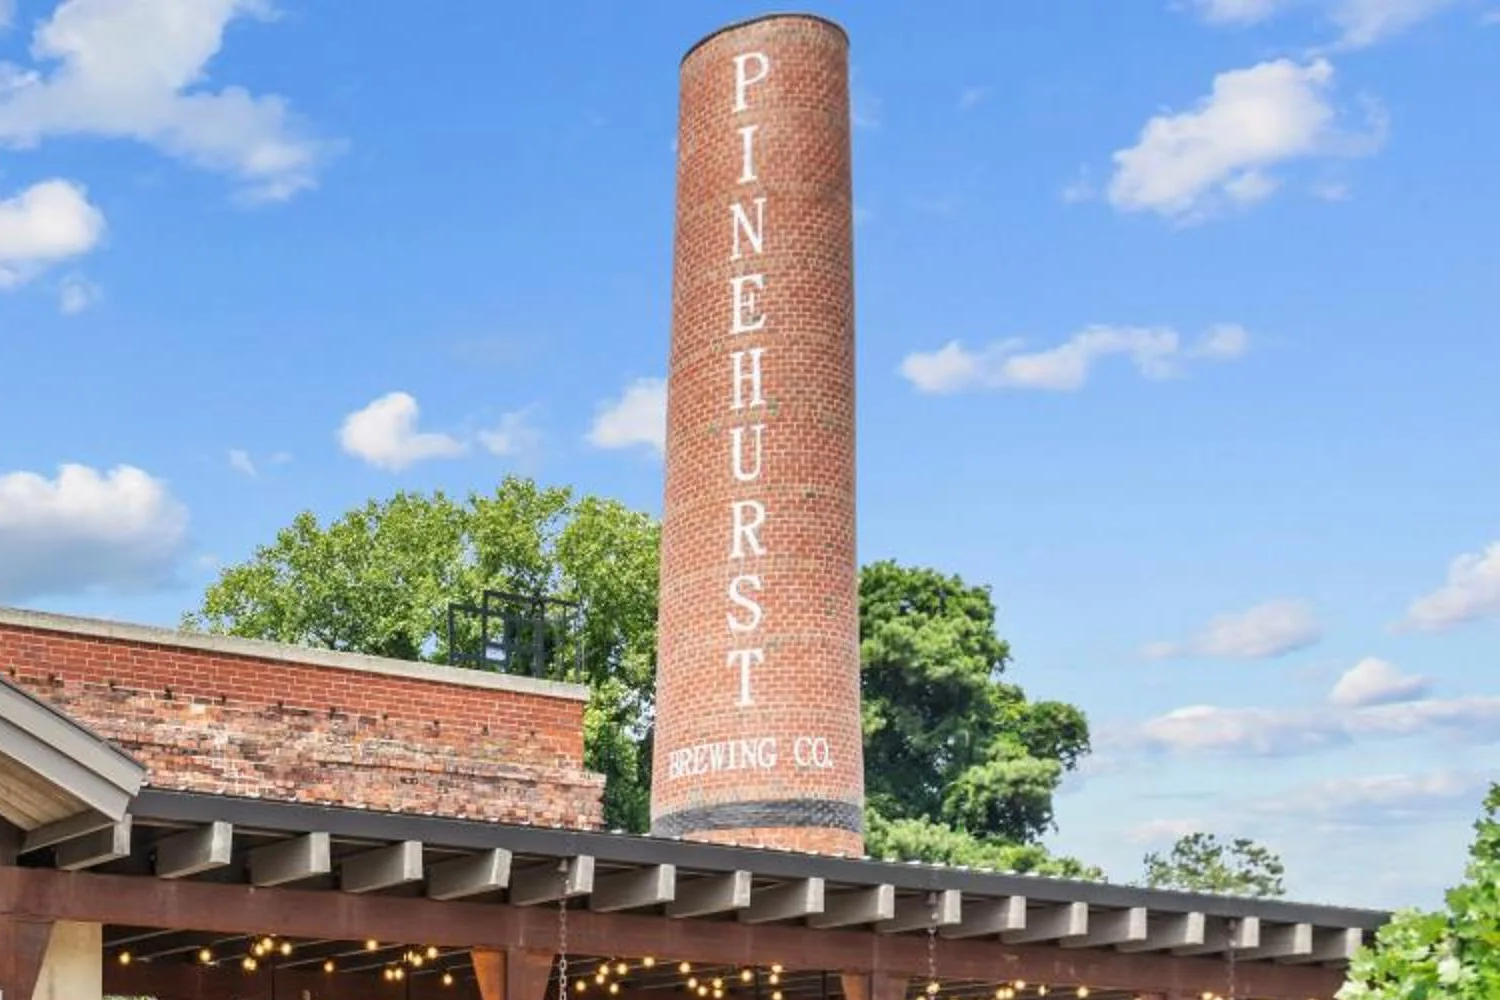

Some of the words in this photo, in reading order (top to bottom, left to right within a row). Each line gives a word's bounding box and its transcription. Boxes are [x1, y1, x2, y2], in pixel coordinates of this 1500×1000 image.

[726, 52, 769, 706] PINEHURST
[669, 737, 776, 778] BREWING
[794, 736, 833, 768] CO.
